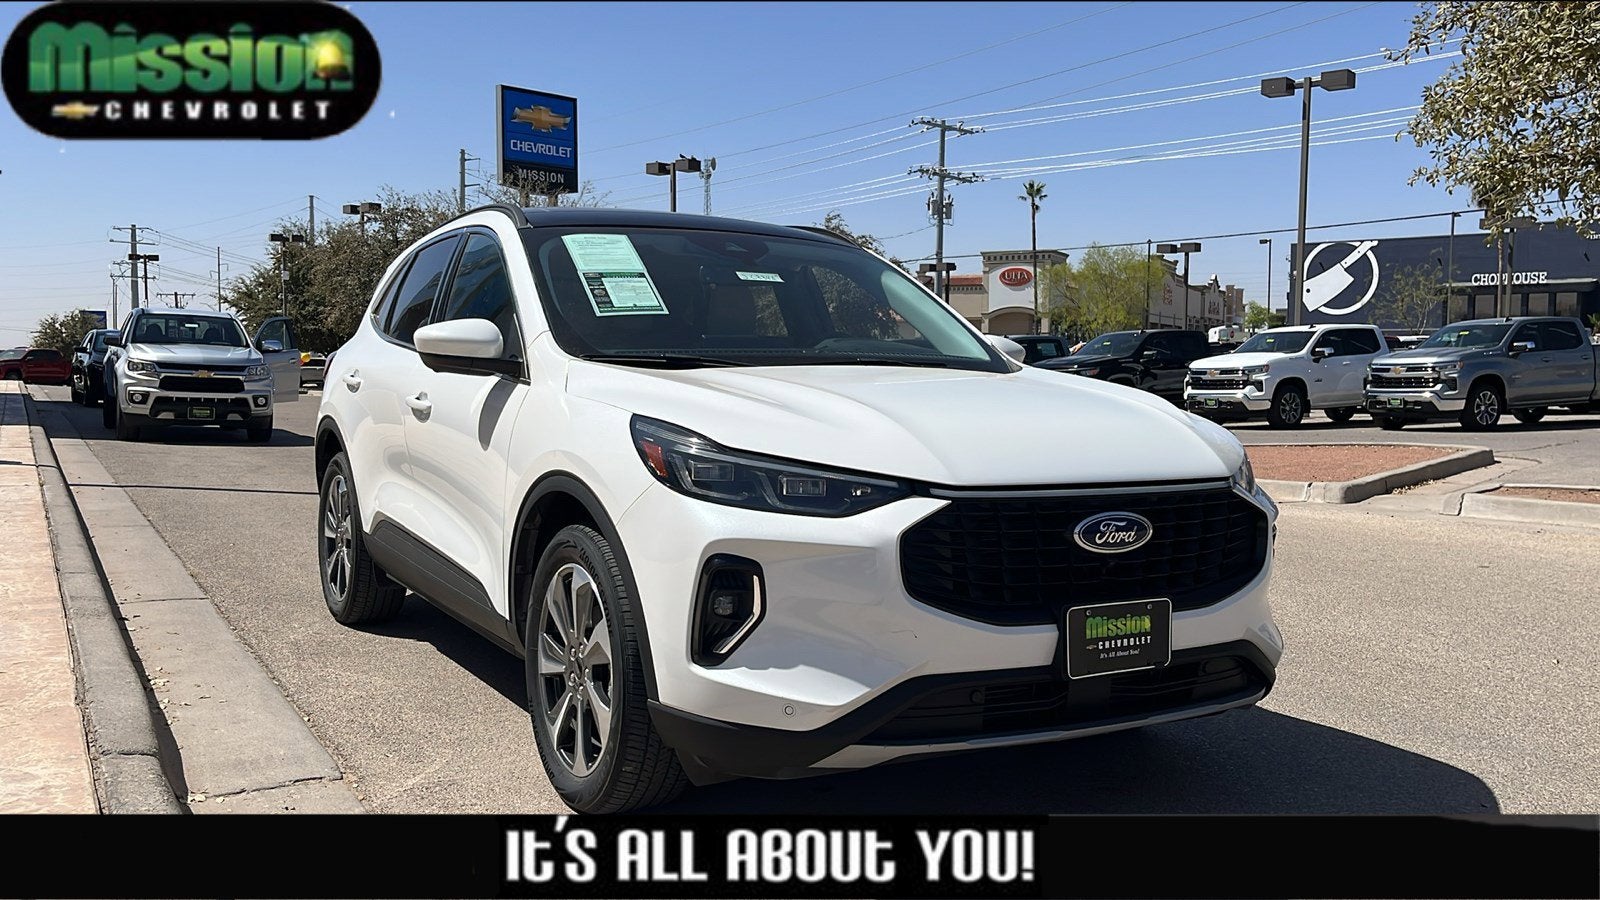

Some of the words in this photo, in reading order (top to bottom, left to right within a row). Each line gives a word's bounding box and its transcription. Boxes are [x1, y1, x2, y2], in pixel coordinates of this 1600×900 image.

[510, 139, 572, 158] CHEVROLET
[518, 168, 565, 184] MISSION
[1095, 520, 1137, 544] Ford
[1086, 613, 1151, 639] Mission
[1098, 635, 1151, 650] CHEVROLET
